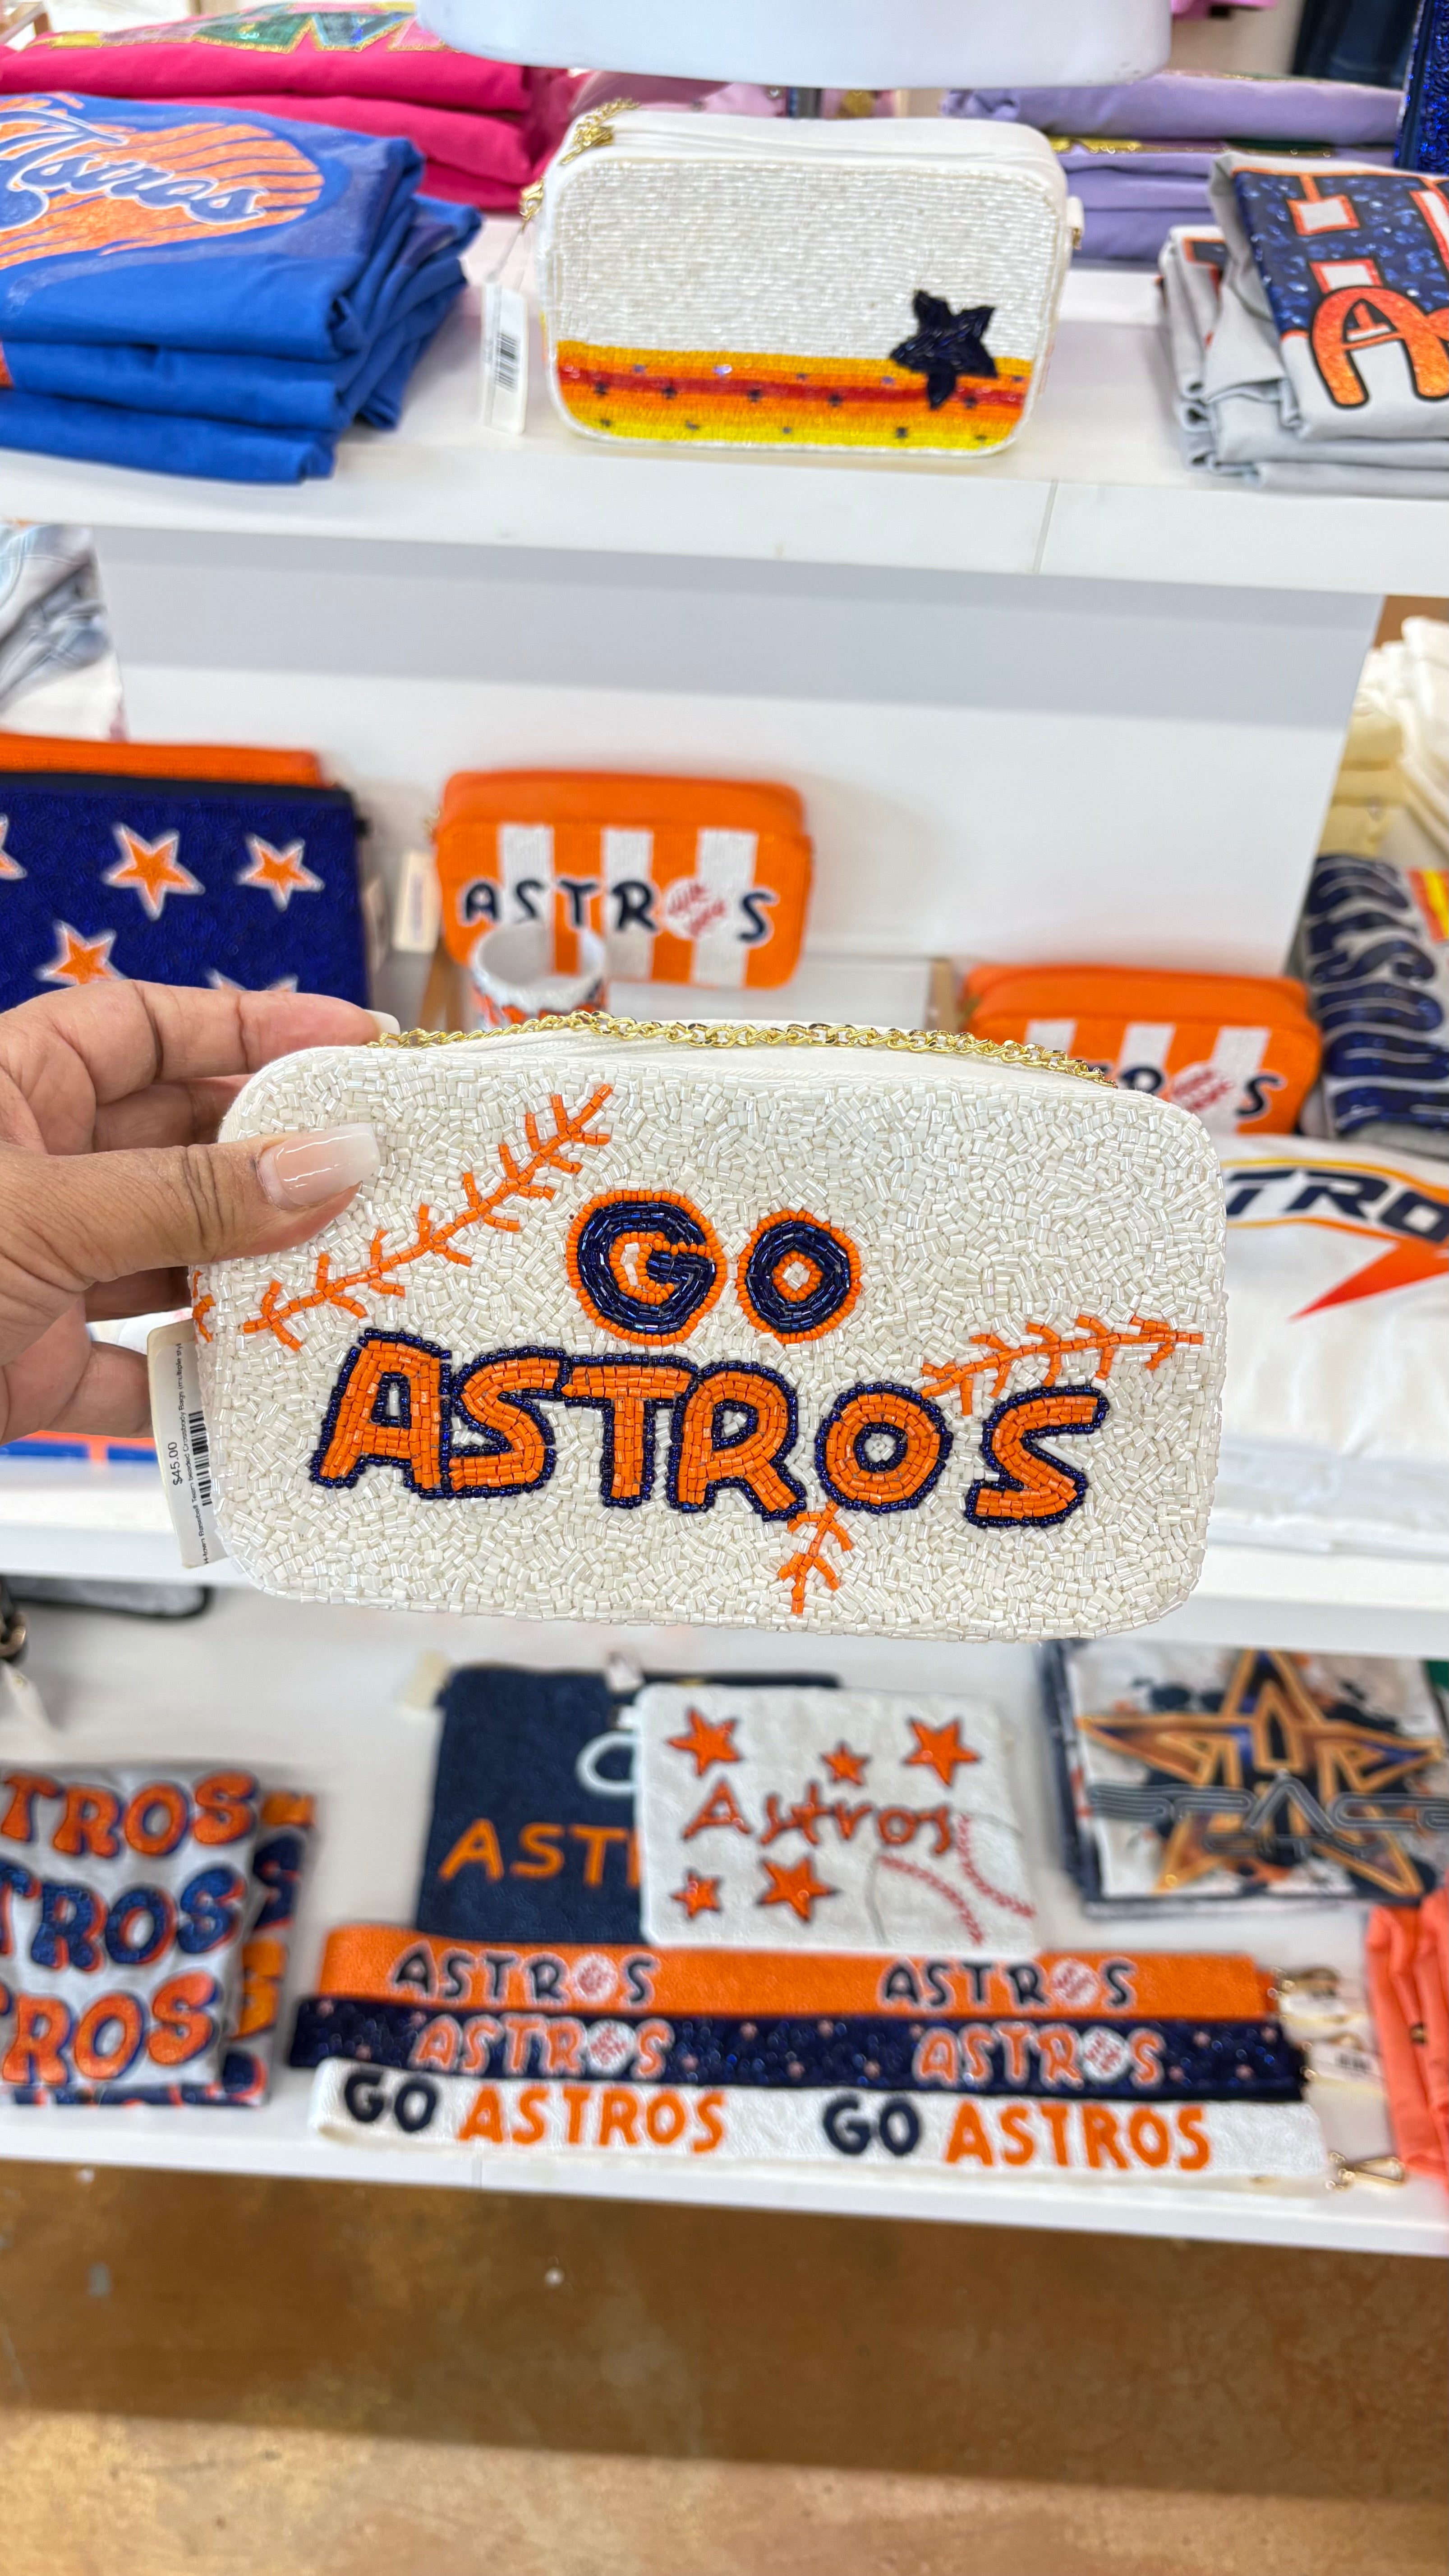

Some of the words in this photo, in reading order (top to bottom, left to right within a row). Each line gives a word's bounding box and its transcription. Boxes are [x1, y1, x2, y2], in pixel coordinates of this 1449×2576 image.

[566, 1189, 861, 1345] GO
[177, 1391, 186, 1411] Bags
[179, 1412, 189, 1452] Crossbody
[310, 1328, 1109, 1528] ASTROS
[168, 1441, 182, 1486] $45.00
[184, 1454, 193, 1481] beaded
[190, 1483, 198, 1503] Team
[193, 1505, 205, 1536] Baseball
[437, 1817, 642, 1888] AST
[682, 1779, 954, 1856] Astros
[0, 1970, 221, 2084] ROS
[344, 2072, 440, 2133] GO
[457, 2083, 726, 2153] ASTROS
[822, 2093, 921, 2157] GO
[943, 2099, 1213, 2171] ASTROS
